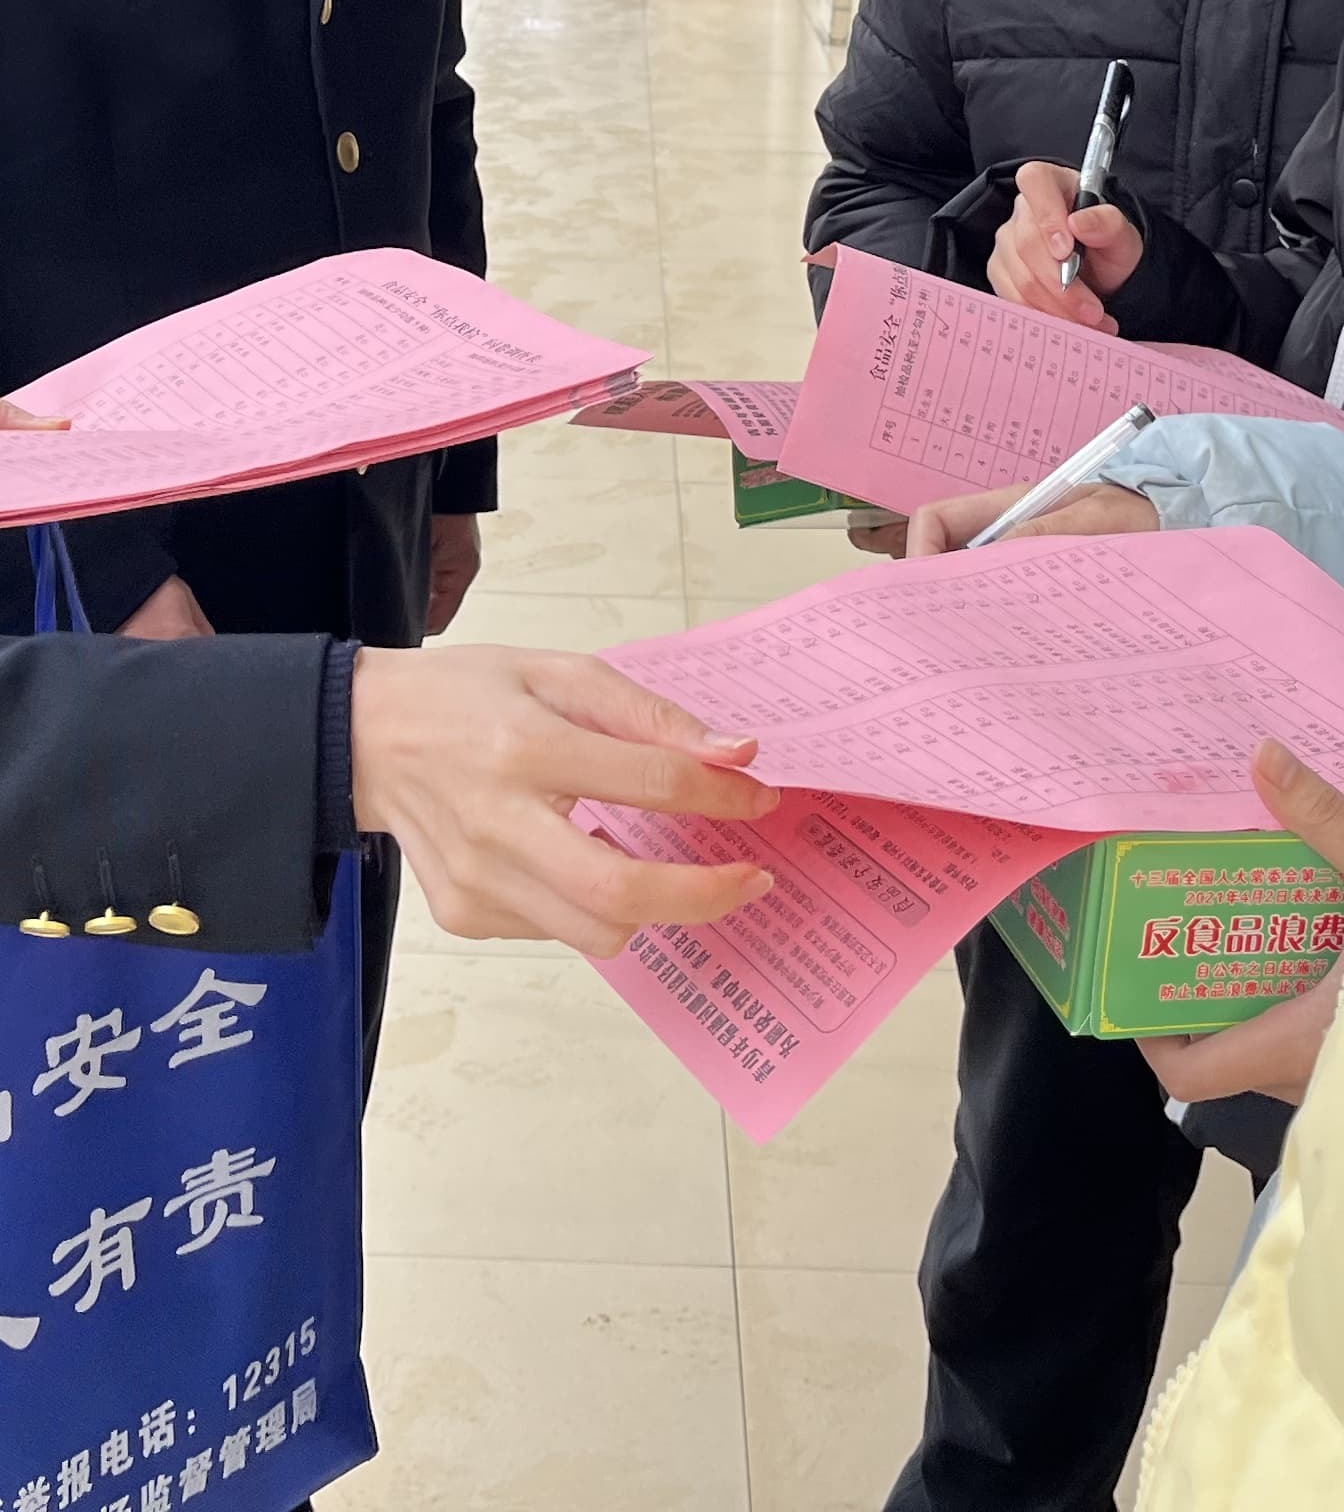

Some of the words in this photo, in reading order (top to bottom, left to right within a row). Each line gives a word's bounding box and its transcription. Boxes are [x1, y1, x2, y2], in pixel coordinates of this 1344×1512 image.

[1196, 959, 1328, 979] 自公布之日起施行
